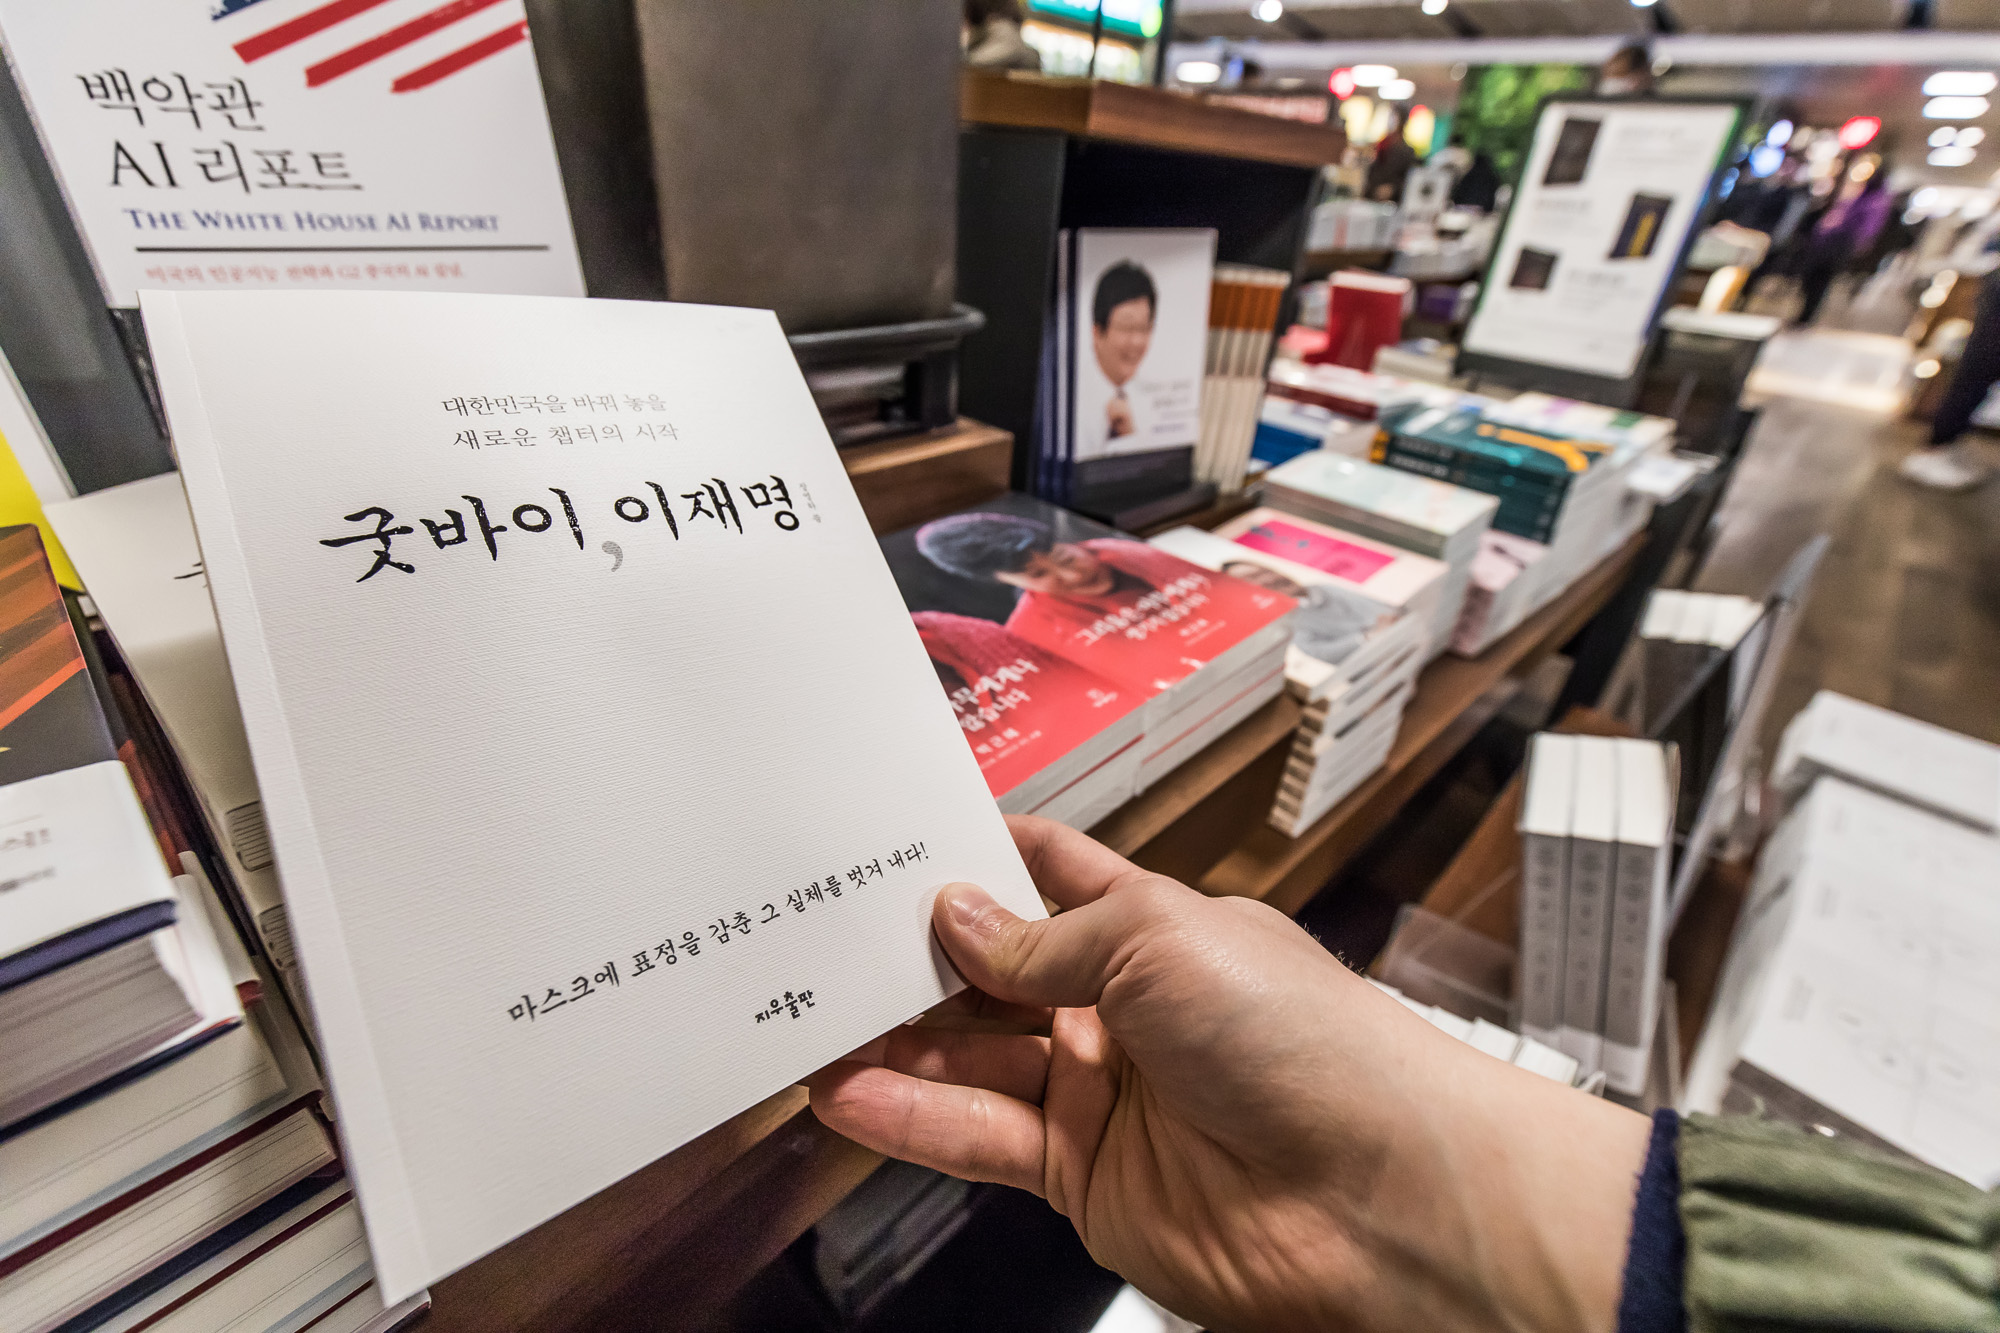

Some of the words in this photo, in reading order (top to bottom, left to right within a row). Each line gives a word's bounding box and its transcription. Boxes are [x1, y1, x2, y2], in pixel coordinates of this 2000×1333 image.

[75, 67, 266, 132] 백악관
[110, 139, 181, 189] AI
[192, 139, 364, 194] 리포트
[122, 207, 188, 231] THE
[191, 209, 287, 232] WHITE
[293, 210, 379, 233] HOUSE
[386, 212, 412, 232] AI
[417, 212, 499, 233] REPORT
[441, 394, 567, 416] 대한민국을
[571, 393, 619, 413] 바꿔
[623, 393, 667, 413] 놓을
[453, 427, 538, 450] 새로운
[547, 424, 624, 446] 챕터의
[635, 422, 679, 442] 시작
[614, 474, 801, 541] 이재명
[506, 960, 621, 1023] 마스크에
[630, 930, 702, 978] 표정을
[707, 910, 752, 945] 감춘
[760, 902, 781, 925] 그
[785, 874, 843, 914] 실체를
[845, 858, 884, 891] 벗겨
[886, 841, 930, 870] 내다!
[754, 989, 816, 1024] 지우출판
